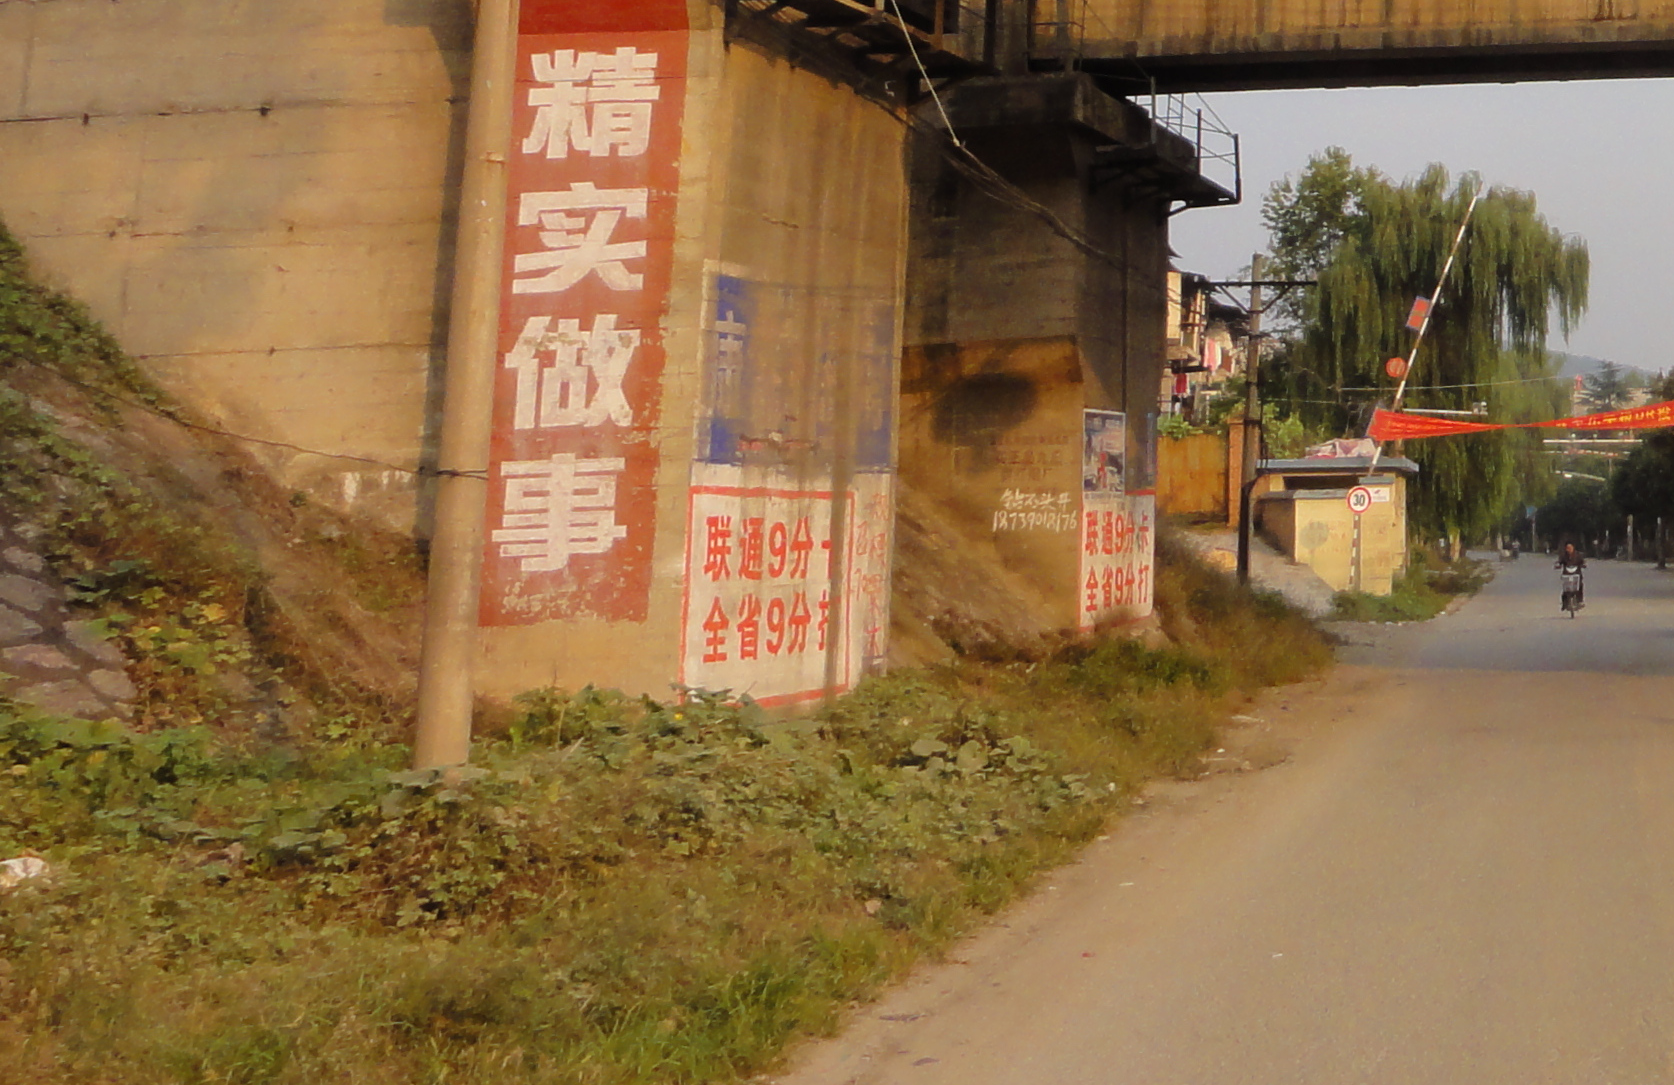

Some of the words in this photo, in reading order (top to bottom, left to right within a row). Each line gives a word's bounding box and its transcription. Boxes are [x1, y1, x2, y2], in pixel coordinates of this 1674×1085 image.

[491, 45, 661, 573] 精实做事
[1353, 494, 1366, 507] 30
[1085, 510, 1149, 556] 联通9分卡
[1085, 562, 1149, 612] 全省9分打
